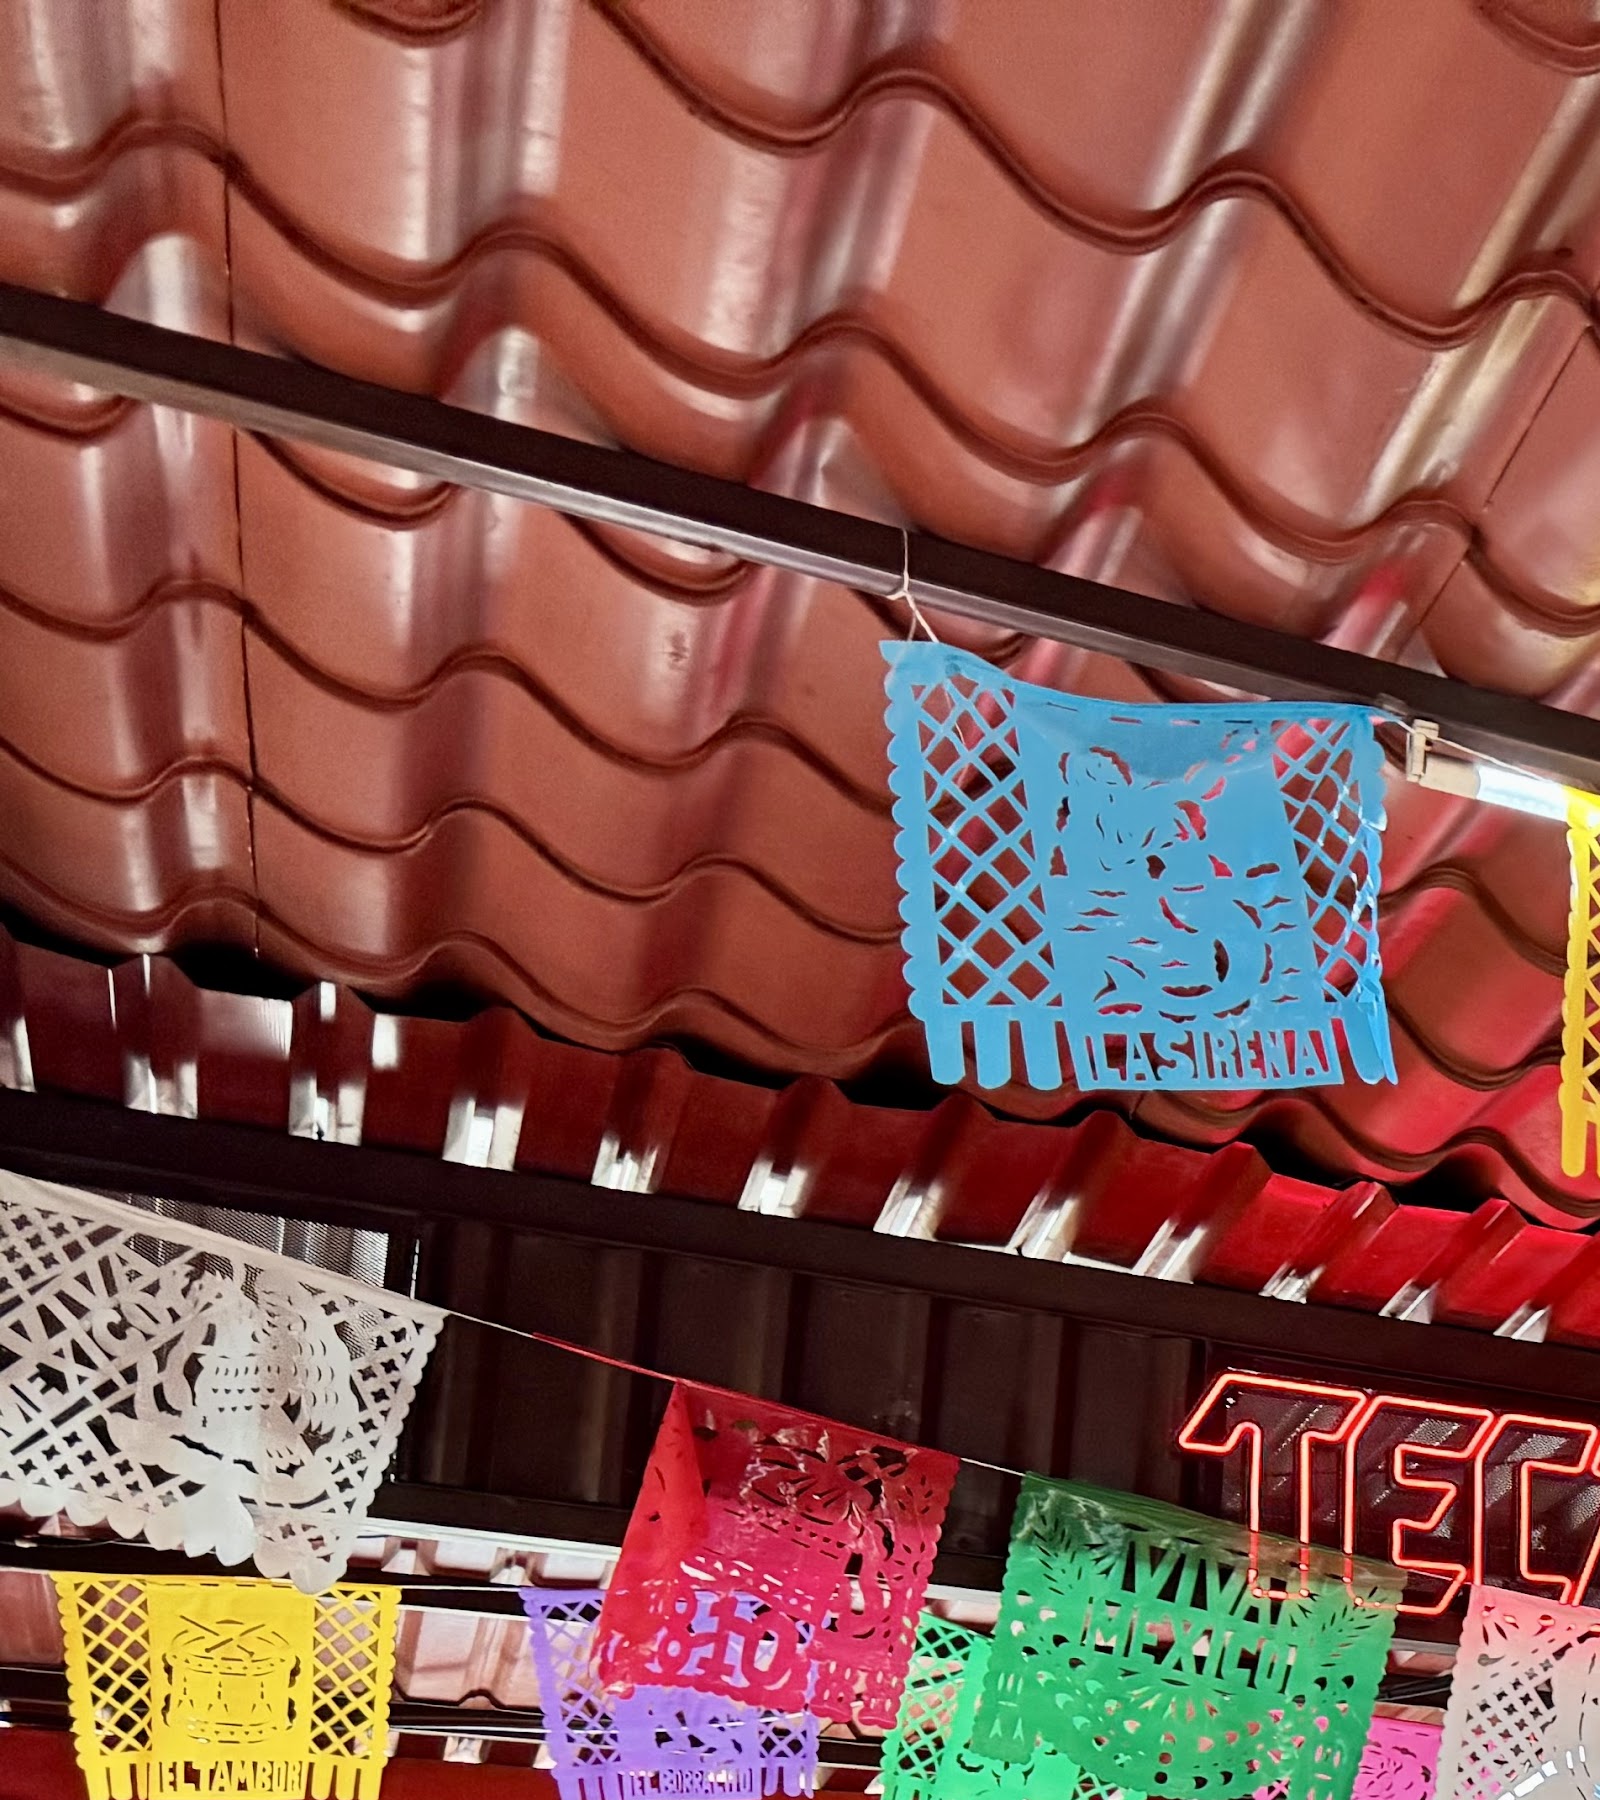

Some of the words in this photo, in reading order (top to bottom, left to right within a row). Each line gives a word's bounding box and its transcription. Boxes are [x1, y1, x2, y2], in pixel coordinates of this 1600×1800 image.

[1090, 1030, 1153, 1082] LA
[1154, 1030, 1326, 1081] SIRENA
[1130, 1541, 1278, 1626] VIVA
[1085, 1597, 1291, 1693] MEXICO
[162, 1761, 197, 1792] EL
[192, 1761, 303, 1792] TAMBOR
[633, 1772, 659, 1796] EL
